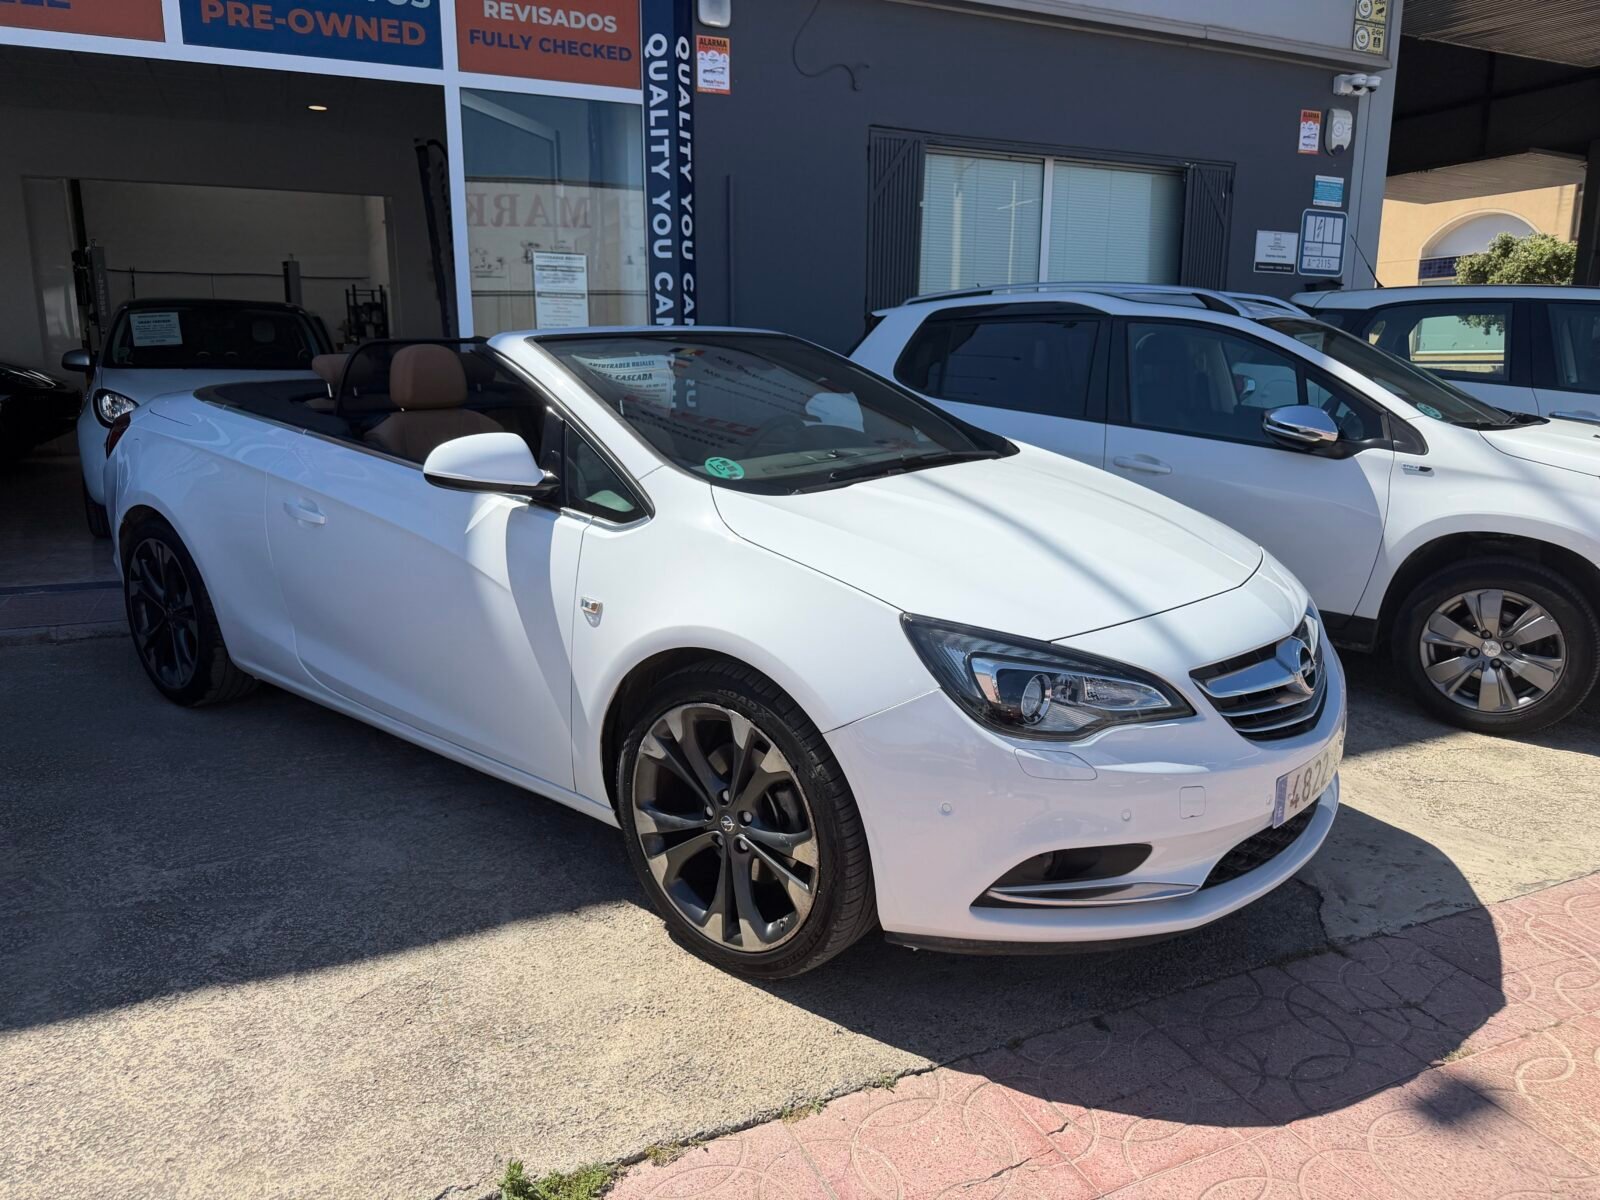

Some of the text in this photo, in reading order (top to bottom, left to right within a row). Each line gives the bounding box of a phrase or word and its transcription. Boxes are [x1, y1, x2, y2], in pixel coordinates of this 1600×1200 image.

[201, 0, 427, 46] PRE-OWNED
[483, 0, 618, 33] REVISADOS
[698, 37, 728, 48] ALARMA
[469, 29, 632, 62] FULLY CHECKED
[644, 33, 671, 180] QUALITY
[675, 36, 693, 183] QUALITY
[652, 190, 673, 259] YOU
[680, 193, 693, 260] YOU
[615, 372, 653, 381] CASCADA
[1287, 751, 1329, 809] 4822
